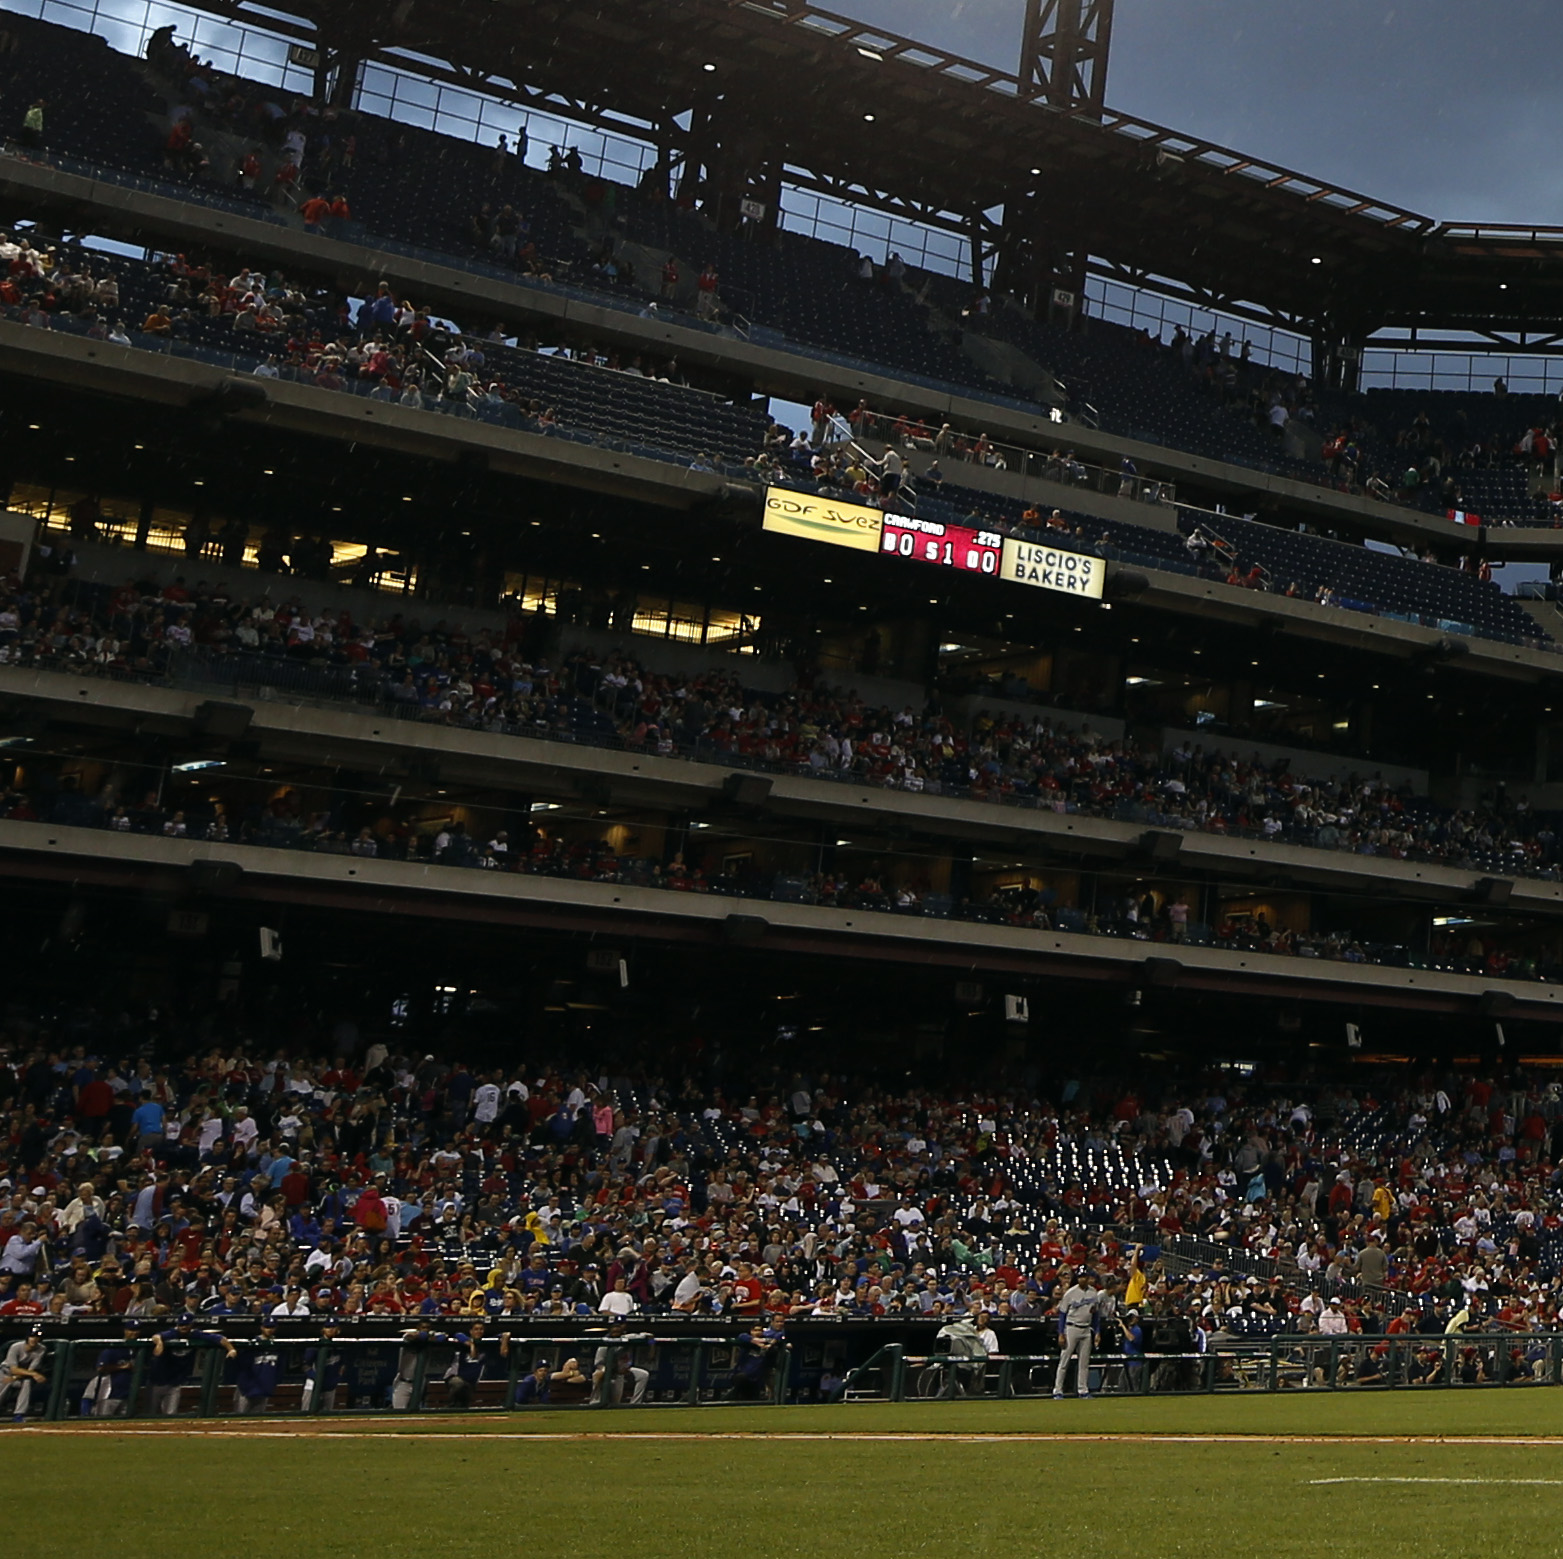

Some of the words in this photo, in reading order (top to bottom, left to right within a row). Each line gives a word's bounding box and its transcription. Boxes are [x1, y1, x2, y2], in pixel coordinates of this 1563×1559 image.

[767, 498, 818, 517] GDF
[884, 512, 945, 536] CRAWFORD
[972, 531, 1001, 548] .275
[900, 536, 913, 556] 0
[926, 543, 938, 560] S
[942, 543, 953, 565] 1
[982, 553, 995, 573] 0
[1016, 544, 1092, 574] LISCIO'S
[1015, 563, 1089, 591] BAKERY
